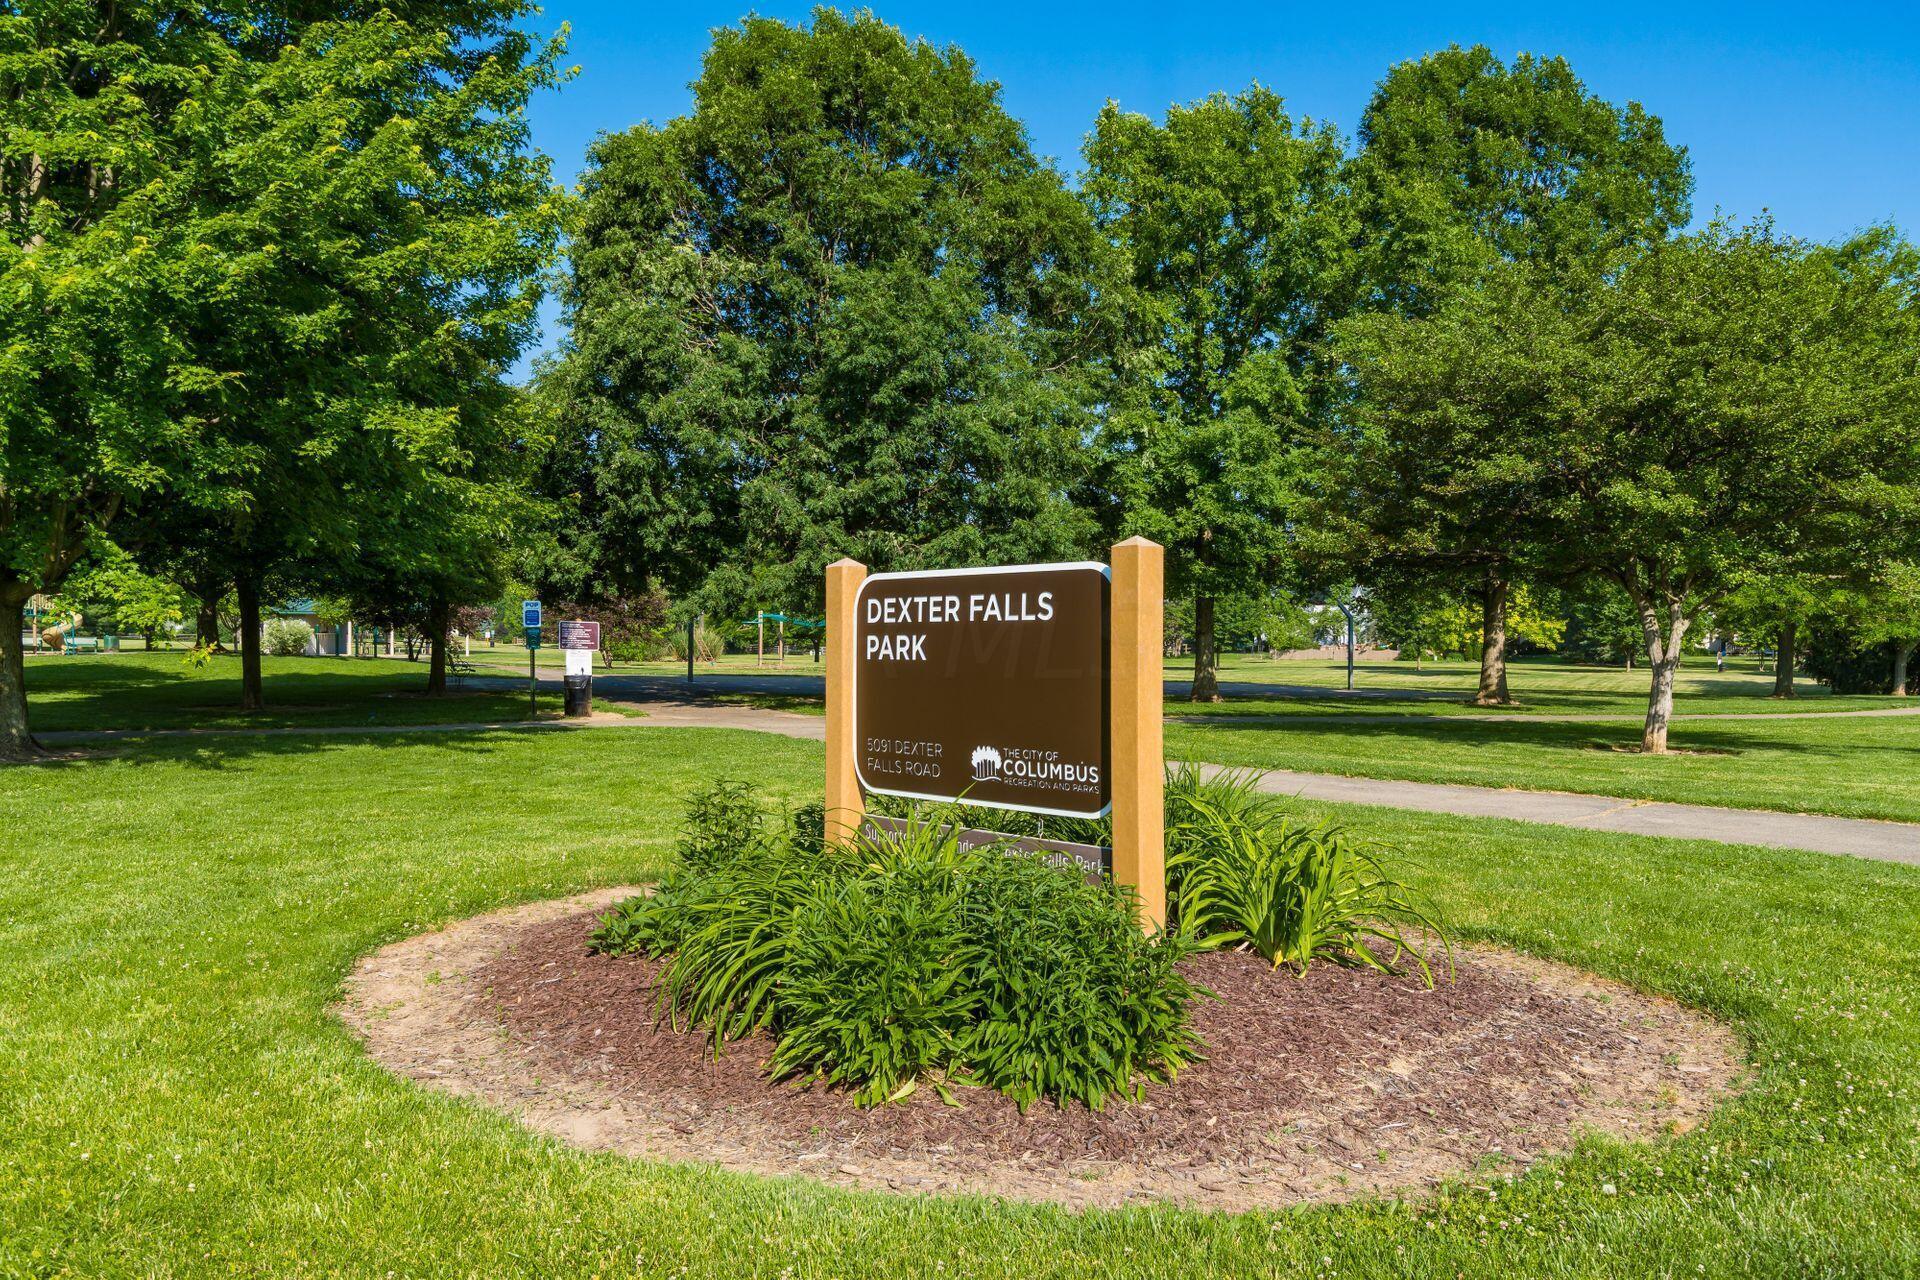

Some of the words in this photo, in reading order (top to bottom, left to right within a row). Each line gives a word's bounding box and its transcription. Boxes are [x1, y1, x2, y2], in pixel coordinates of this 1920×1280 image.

[867, 596, 960, 624] DEXTER
[969, 592, 1054, 622] FALLS
[866, 635, 927, 661] PARK
[867, 738, 892, 753] 5091
[895, 740, 943, 757] DEXTER
[1003, 748, 1020, 759] THE
[1023, 749, 1043, 761] CITY
[1045, 751, 1059, 762] OF
[867, 757, 902, 774] FALLS
[905, 761, 941, 778] ROAD
[1003, 760, 1099, 783] COLUMBUS
[1004, 777, 1051, 789] RECREATION
[1053, 783, 1071, 792] AND
[1072, 784, 1100, 794] PARKS
